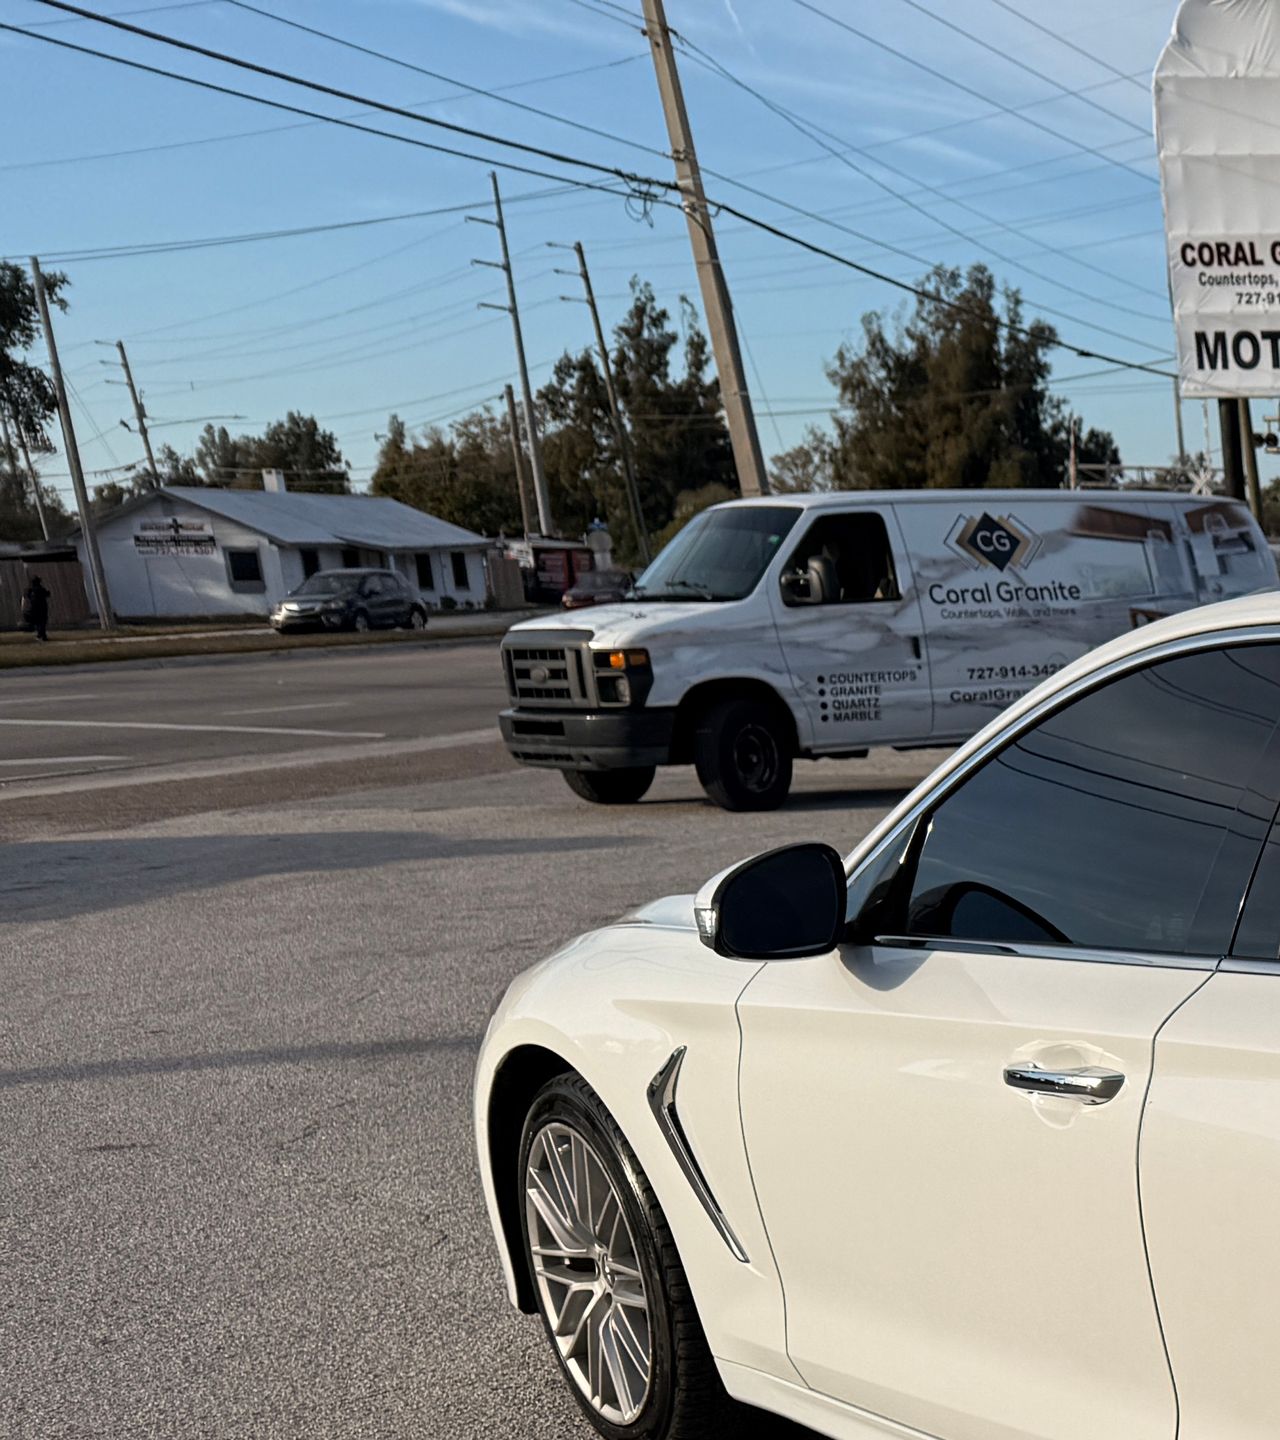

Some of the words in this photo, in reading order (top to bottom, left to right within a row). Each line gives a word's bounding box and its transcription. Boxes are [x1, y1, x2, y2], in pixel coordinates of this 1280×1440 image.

[1181, 241, 1264, 267] CORAL
[1198, 271, 1279, 288] Countertops,
[976, 531, 1011, 552] CG
[929, 582, 992, 605] Coral
[996, 580, 1081, 603] Granite
[829, 670, 917, 685] COUNTERTOPS
[830, 685, 882, 697] GRANITE
[832, 698, 881, 711] QUARTZ
[833, 710, 882, 722] MARBLE
